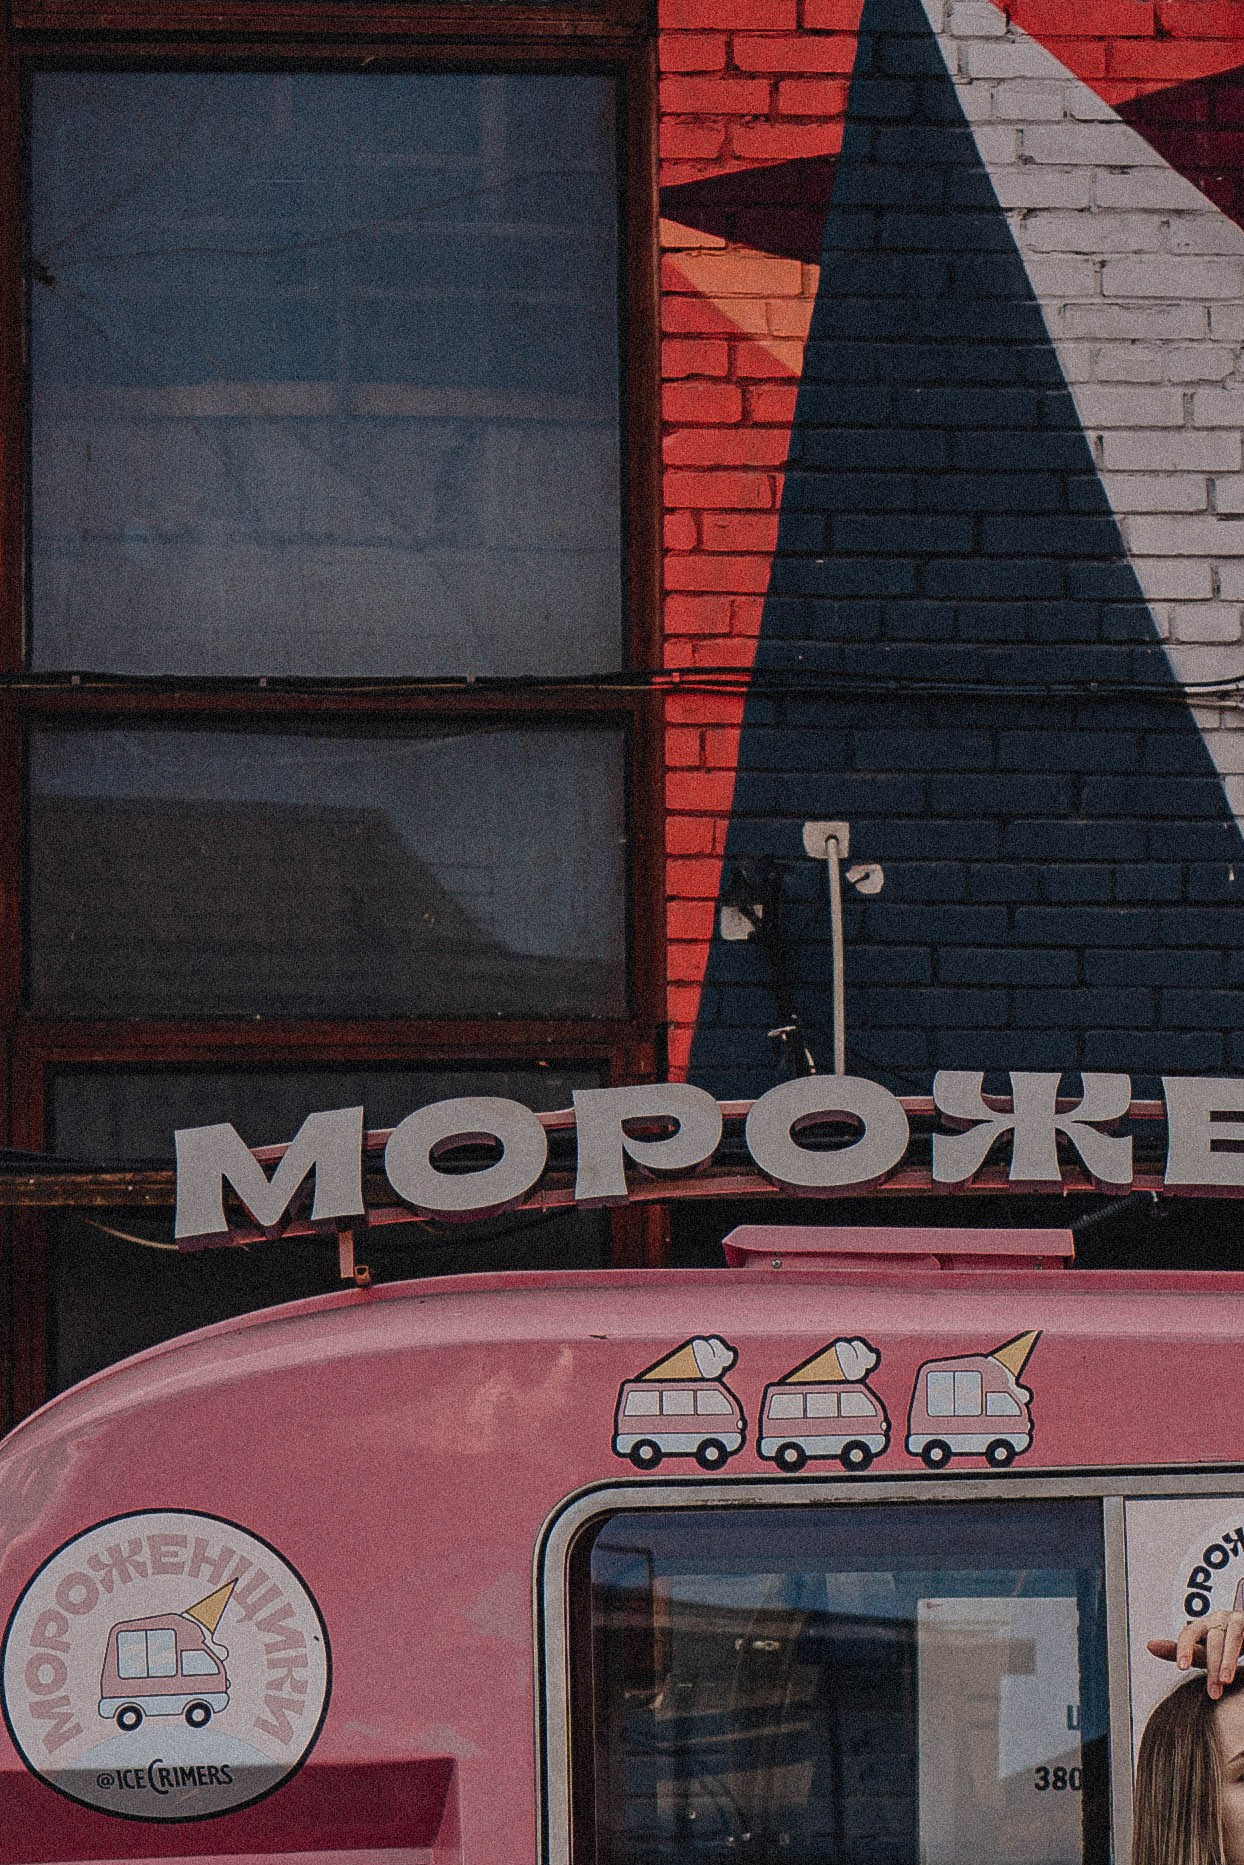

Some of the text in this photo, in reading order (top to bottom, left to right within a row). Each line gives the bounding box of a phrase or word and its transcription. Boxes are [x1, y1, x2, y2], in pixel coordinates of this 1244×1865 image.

[25, 1533, 309, 1754] МОРОЖЕНЩИКИ
[96, 1758, 233, 1795] @ICECRIMERS
[1034, 1766, 1082, 1791] 380
